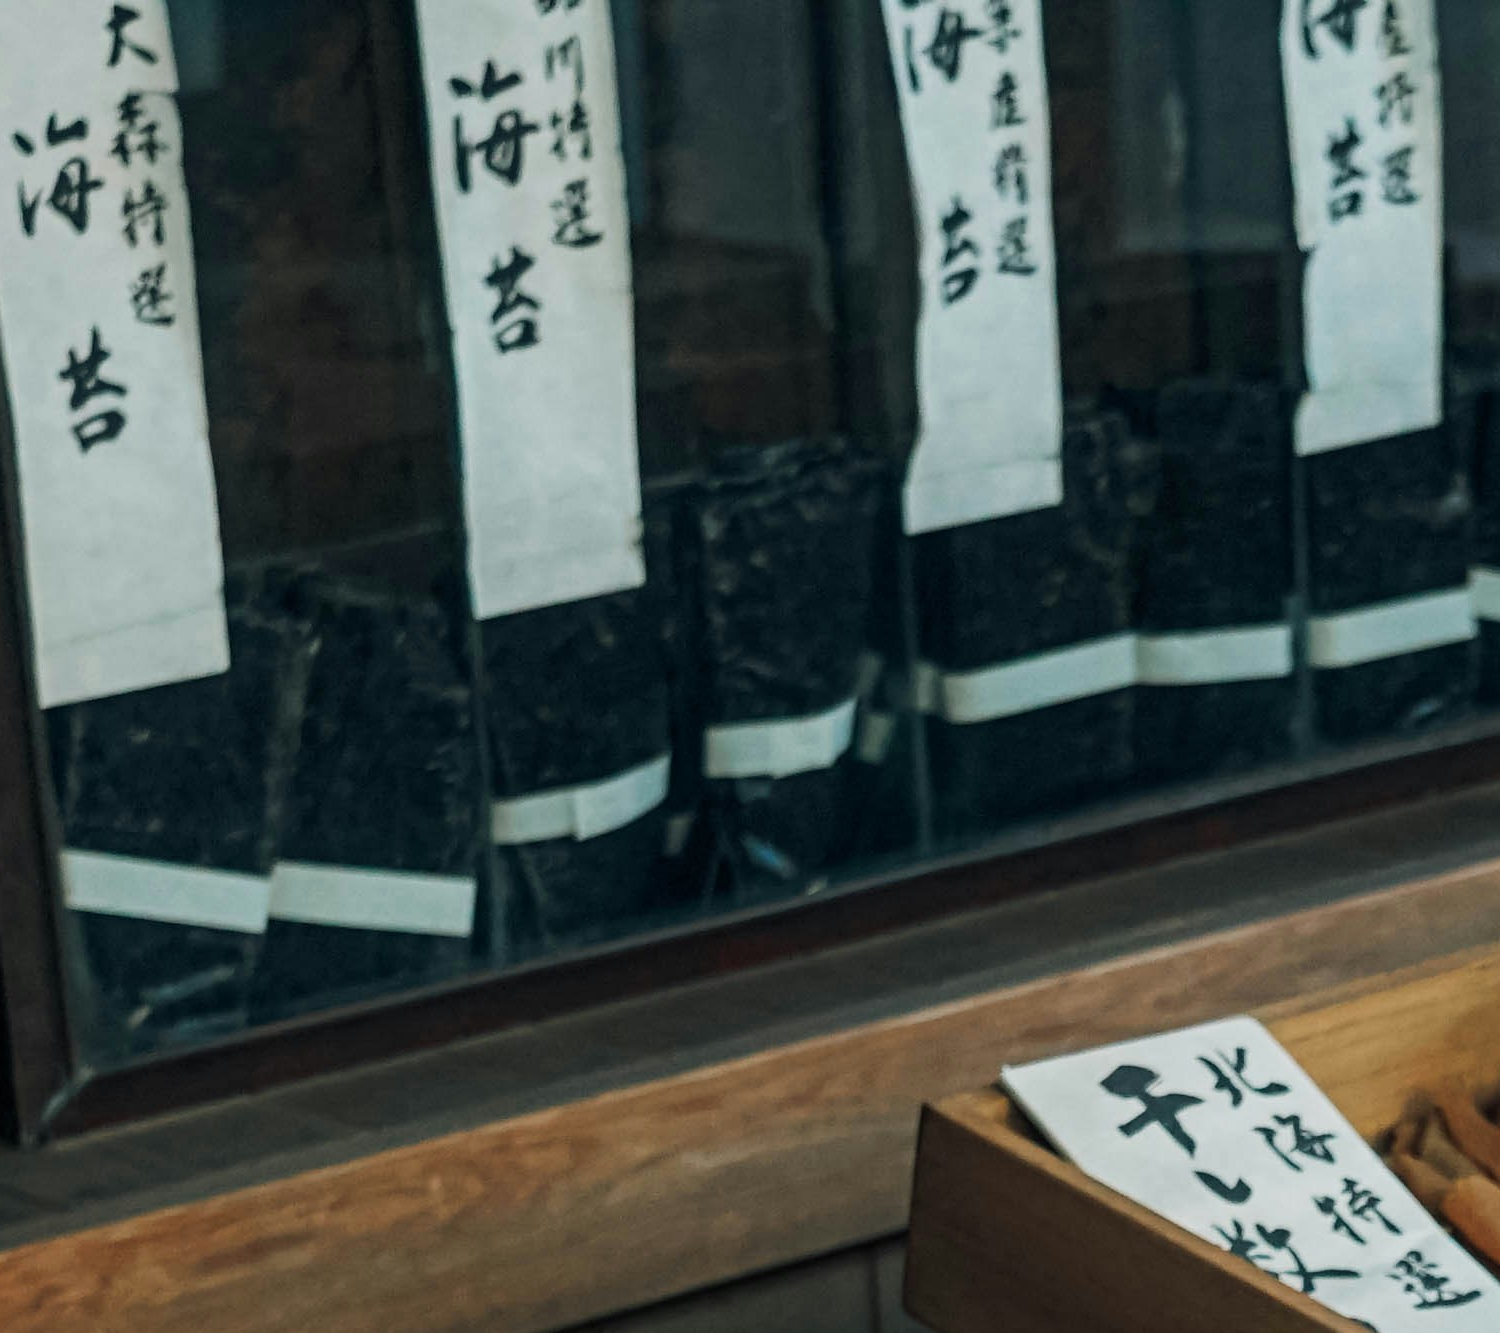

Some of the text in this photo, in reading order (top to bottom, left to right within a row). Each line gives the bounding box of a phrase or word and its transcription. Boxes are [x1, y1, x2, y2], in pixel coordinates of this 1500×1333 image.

[449, 58, 540, 355] 海苔
[534, 0, 604, 248] 川特選
[12, 112, 127, 455] 海苔
